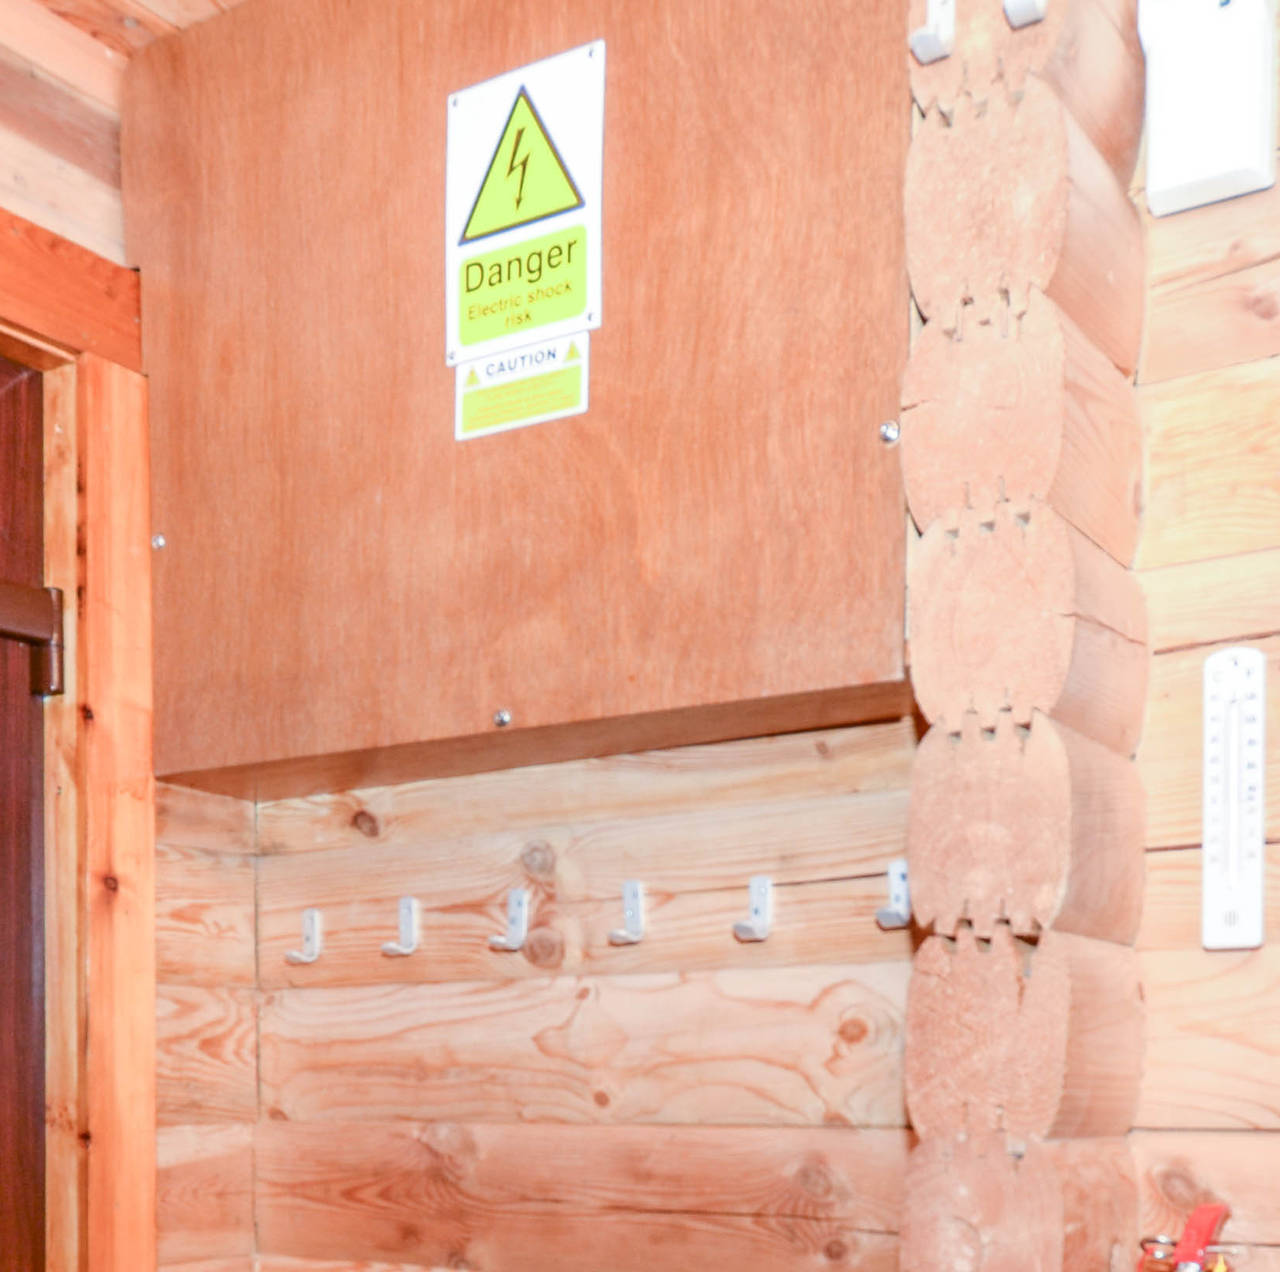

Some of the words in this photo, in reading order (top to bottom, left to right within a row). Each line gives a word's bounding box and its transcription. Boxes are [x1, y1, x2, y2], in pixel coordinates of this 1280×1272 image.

[465, 239, 577, 293] Danger
[468, 295, 521, 321] Electric
[527, 280, 572, 304] shock
[505, 310, 532, 328] risk
[485, 347, 557, 377] CAUTION
